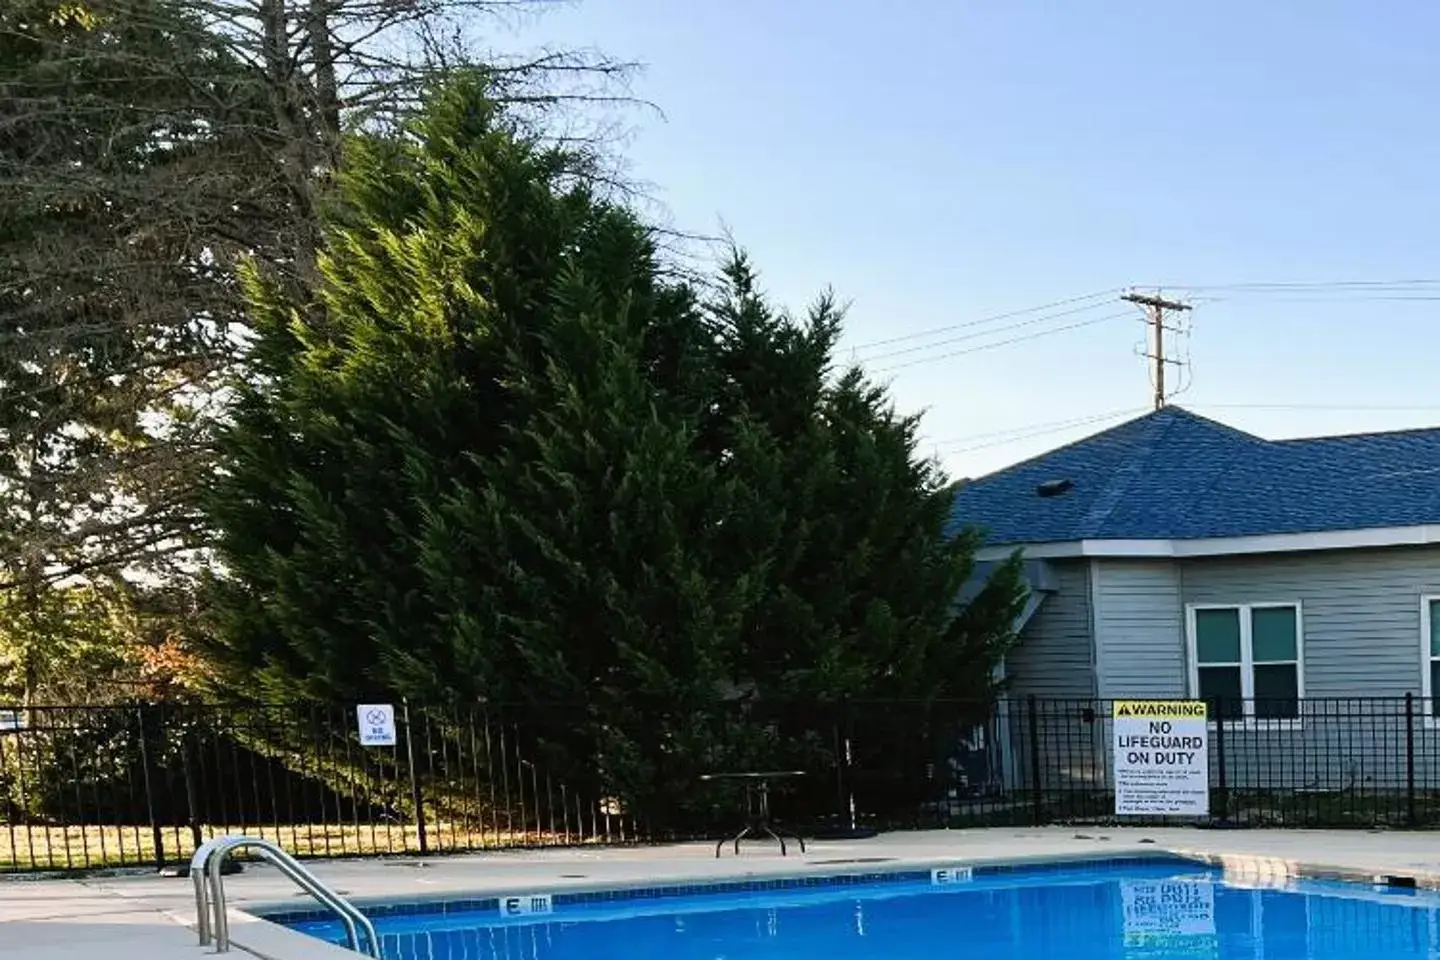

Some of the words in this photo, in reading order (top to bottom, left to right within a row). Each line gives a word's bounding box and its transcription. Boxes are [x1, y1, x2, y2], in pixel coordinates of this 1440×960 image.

[1132, 704, 1204, 716] WARNING
[1149, 721, 1172, 734] NO
[1118, 736, 1203, 750] LIFEGUARD
[1127, 752, 1149, 765] ON
[1155, 752, 1195, 765] DUTY
